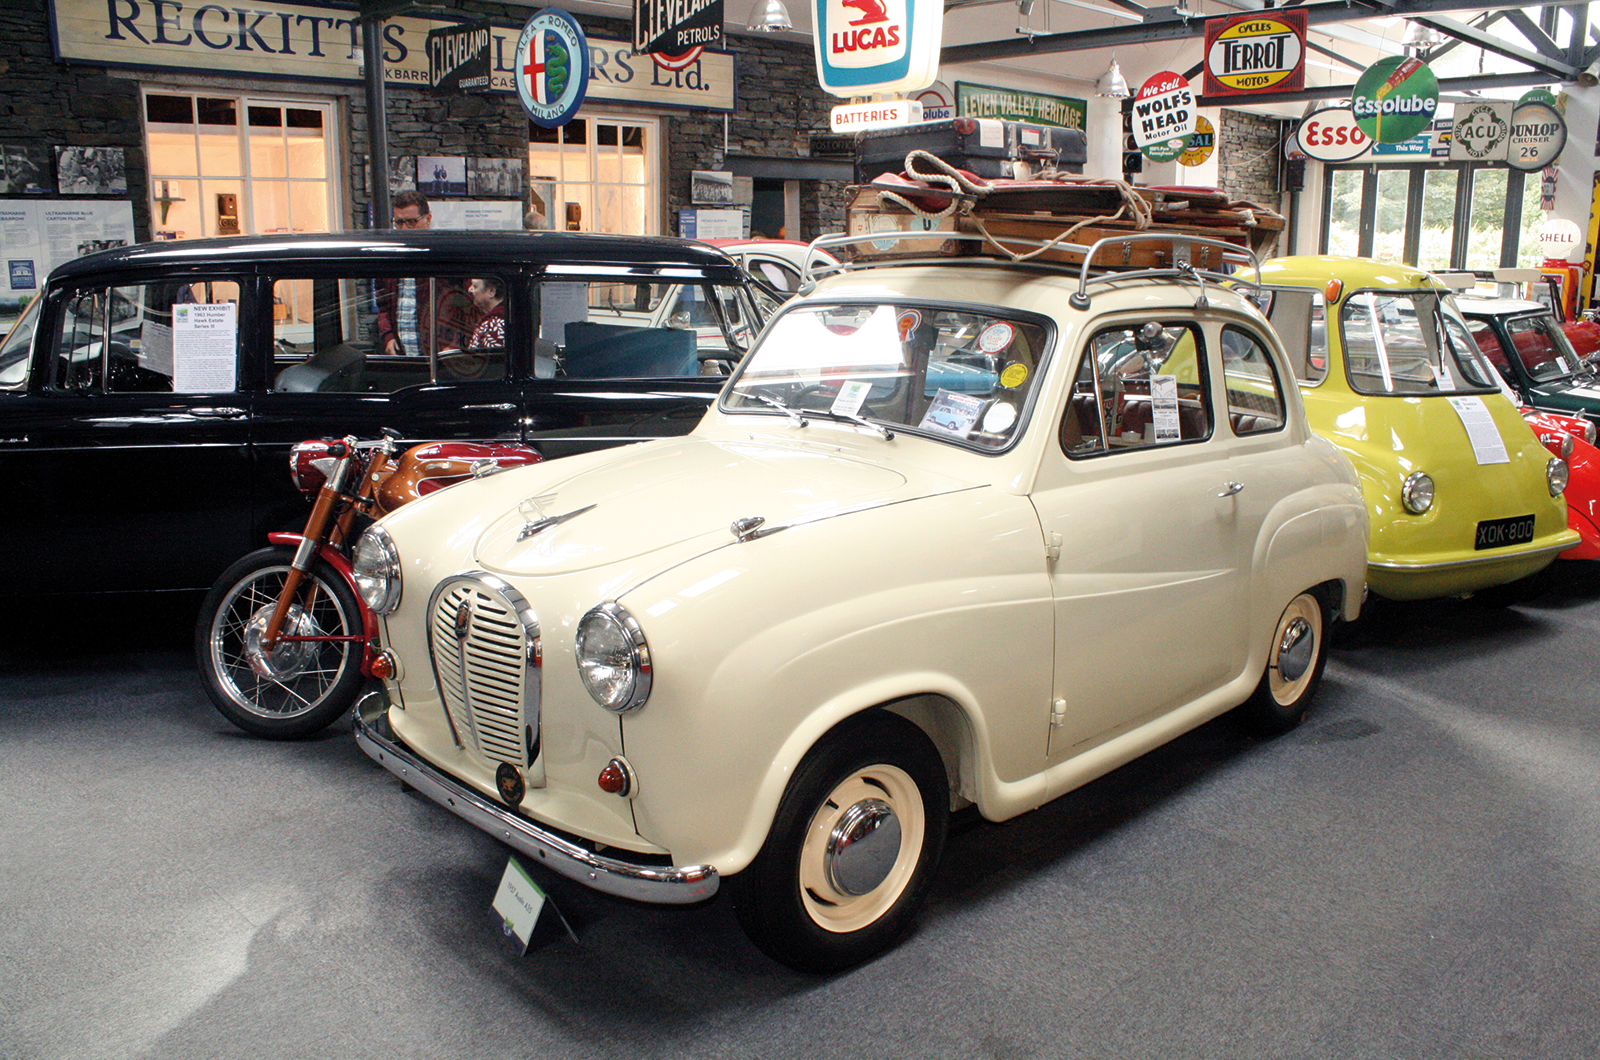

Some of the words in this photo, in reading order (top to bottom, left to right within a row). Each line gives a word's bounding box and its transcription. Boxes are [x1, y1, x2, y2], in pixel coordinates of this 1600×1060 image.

[518, 24, 537, 55] ALFA
[548, 15, 577, 47] ROMEO
[677, 25, 720, 46] PETROLS
[1238, 23, 1271, 33] CYCLES
[833, 25, 900, 54] LUCAS
[431, 29, 488, 88] CLEVELAND
[1218, 35, 1291, 73] TERROT
[459, 75, 489, 88] GUARANTEED
[651, 58, 709, 91] Ltd.
[1237, 76, 1269, 86] MOTOS
[1143, 86, 1158, 97] We
[1159, 78, 1180, 92] Sell
[531, 104, 565, 119] MILANO
[963, 93, 997, 117] LEVEN
[1000, 94, 1037, 117] VALLEY
[1038, 98, 1081, 129] HERITAGE
[1136, 90, 1192, 118] WOLF'S
[1353, 94, 1436, 115] Essolube
[1471, 106, 1493, 116] CYCLE
[836, 108, 897, 125] BATTERIES
[1142, 109, 1189, 133] HEAD
[1145, 129, 1171, 141] Motor
[1173, 123, 1187, 133] Oil
[1464, 126, 1496, 138] ACU
[1499, 121, 1507, 143] UNION
[1409, 144, 1424, 152] Way
[1540, 233, 1574, 242] SHELL
